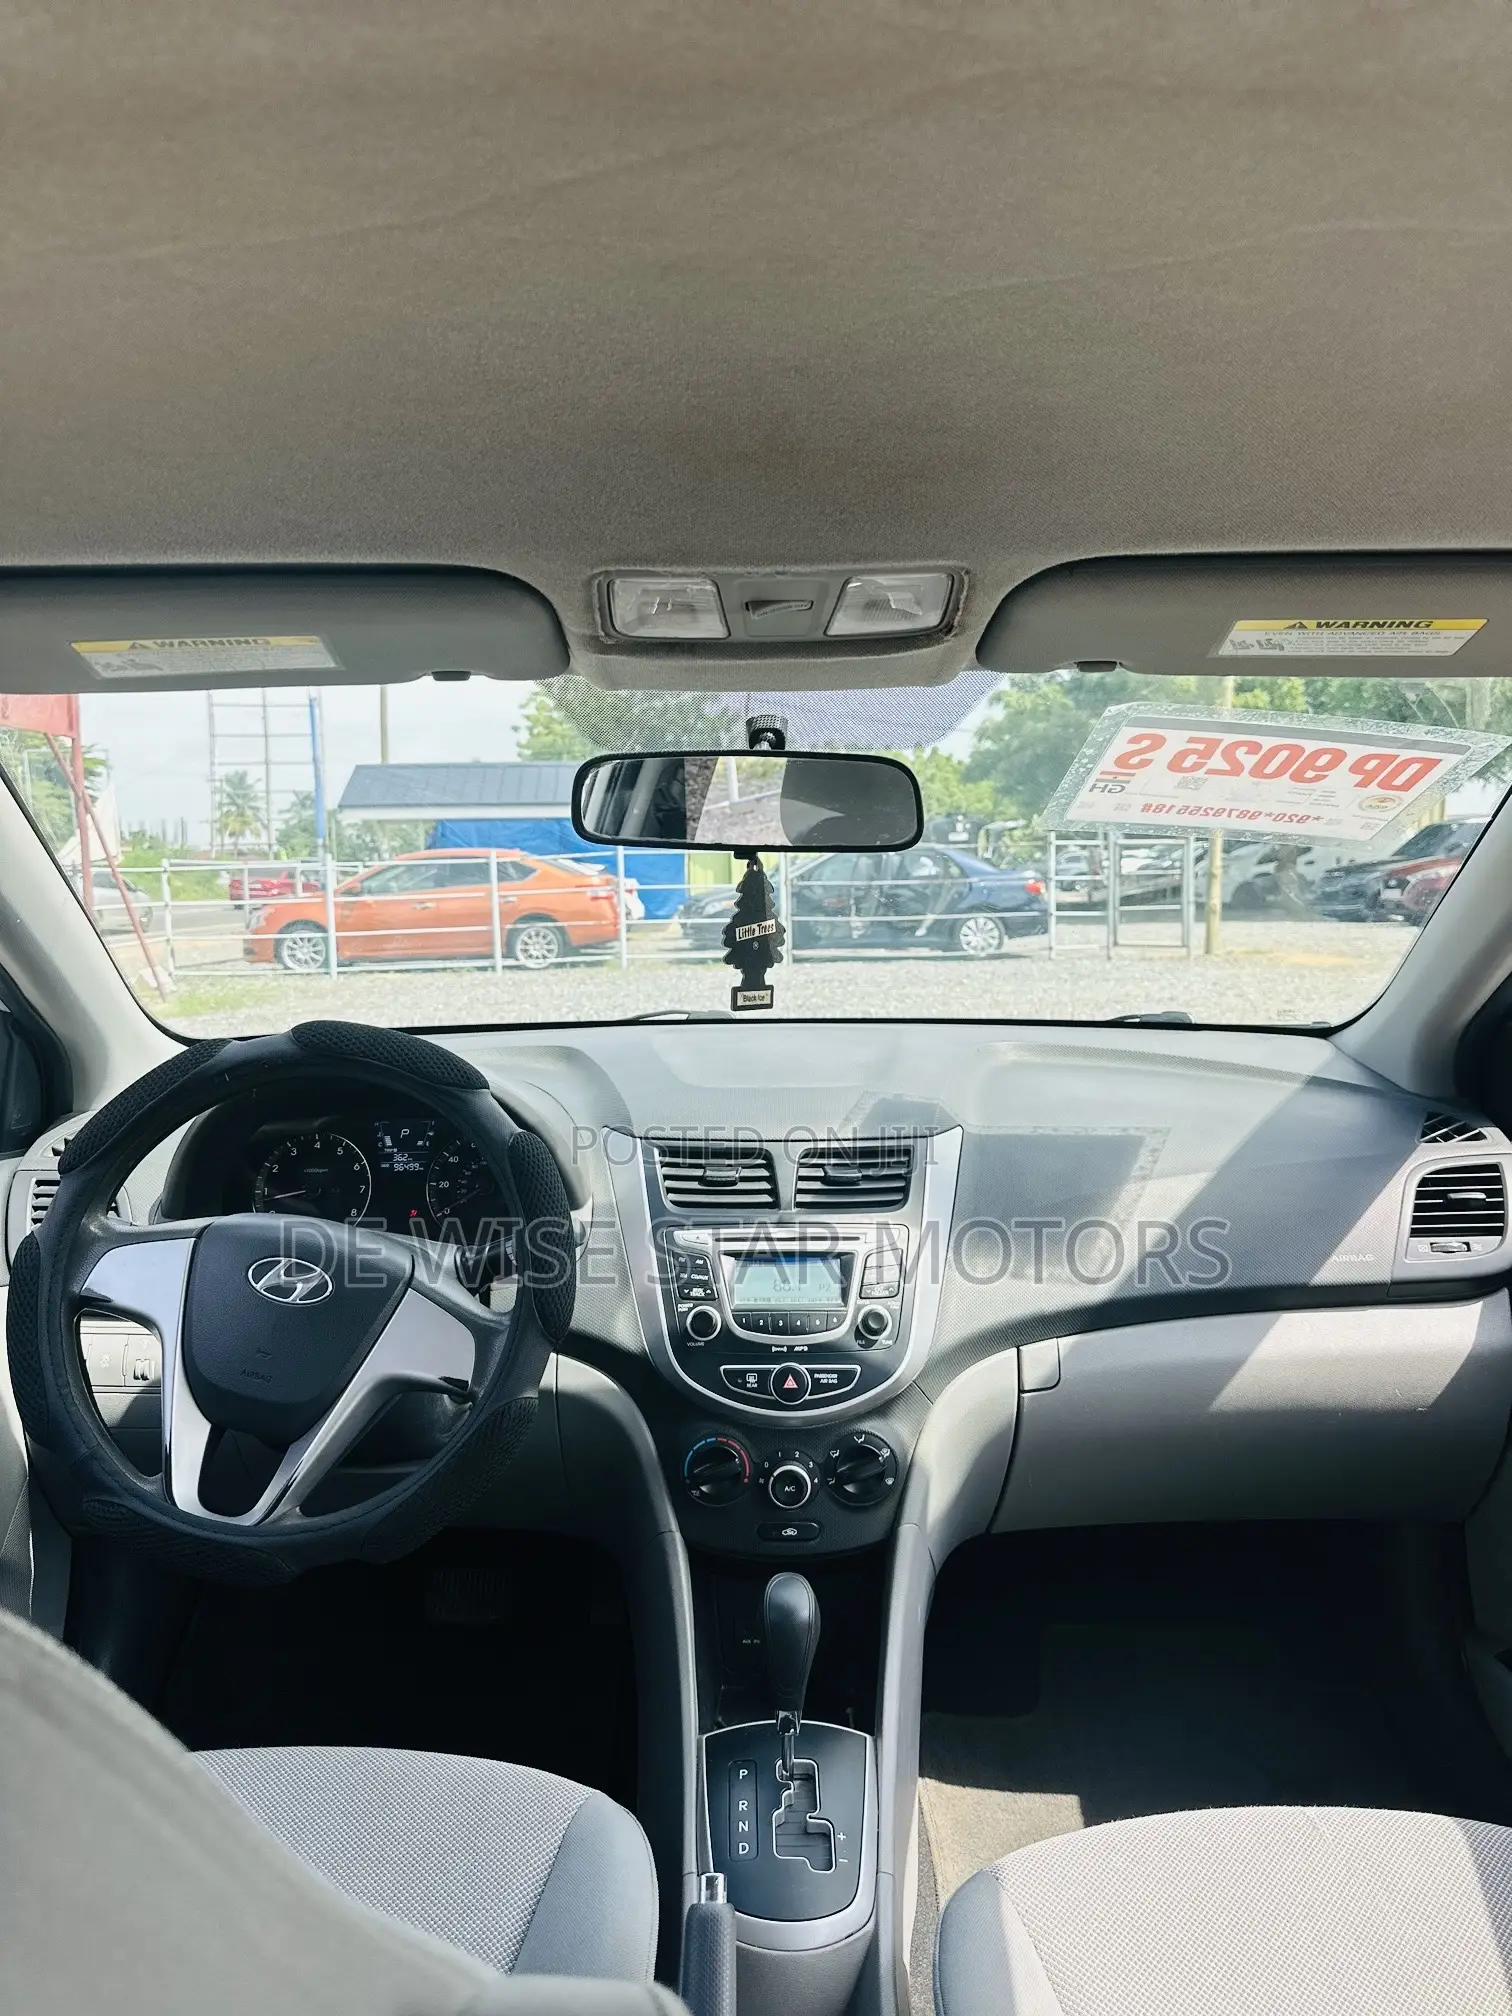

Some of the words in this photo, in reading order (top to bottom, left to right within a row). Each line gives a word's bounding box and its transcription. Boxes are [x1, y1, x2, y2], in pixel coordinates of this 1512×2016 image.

[1315, 620, 1434, 629] WARNING
[152, 639, 272, 649] WARNING
[738, 925, 756, 940] Little
[757, 922, 775, 936] Trees
[400, 1128, 410, 1139] P
[313, 1141, 321, 1149] 4
[290, 1147, 297, 1156] 3
[336, 1147, 344, 1155] 5
[393, 1153, 409, 1162] 362
[448, 1155, 459, 1163] 40
[271, 1164, 279, 1173] 2
[353, 1162, 361, 1171] 6
[438, 1180, 450, 1188] 20
[360, 1185, 366, 1194] 7
[350, 1208, 358, 1217] 8
[808, 1460, 814, 1468] 3
[784, 1485, 796, 1493] A/C
[738, 1768, 749, 1780] P
[738, 1800, 748, 1811] R
[738, 1821, 749, 1833] N
[738, 1842, 749, 1854] D
